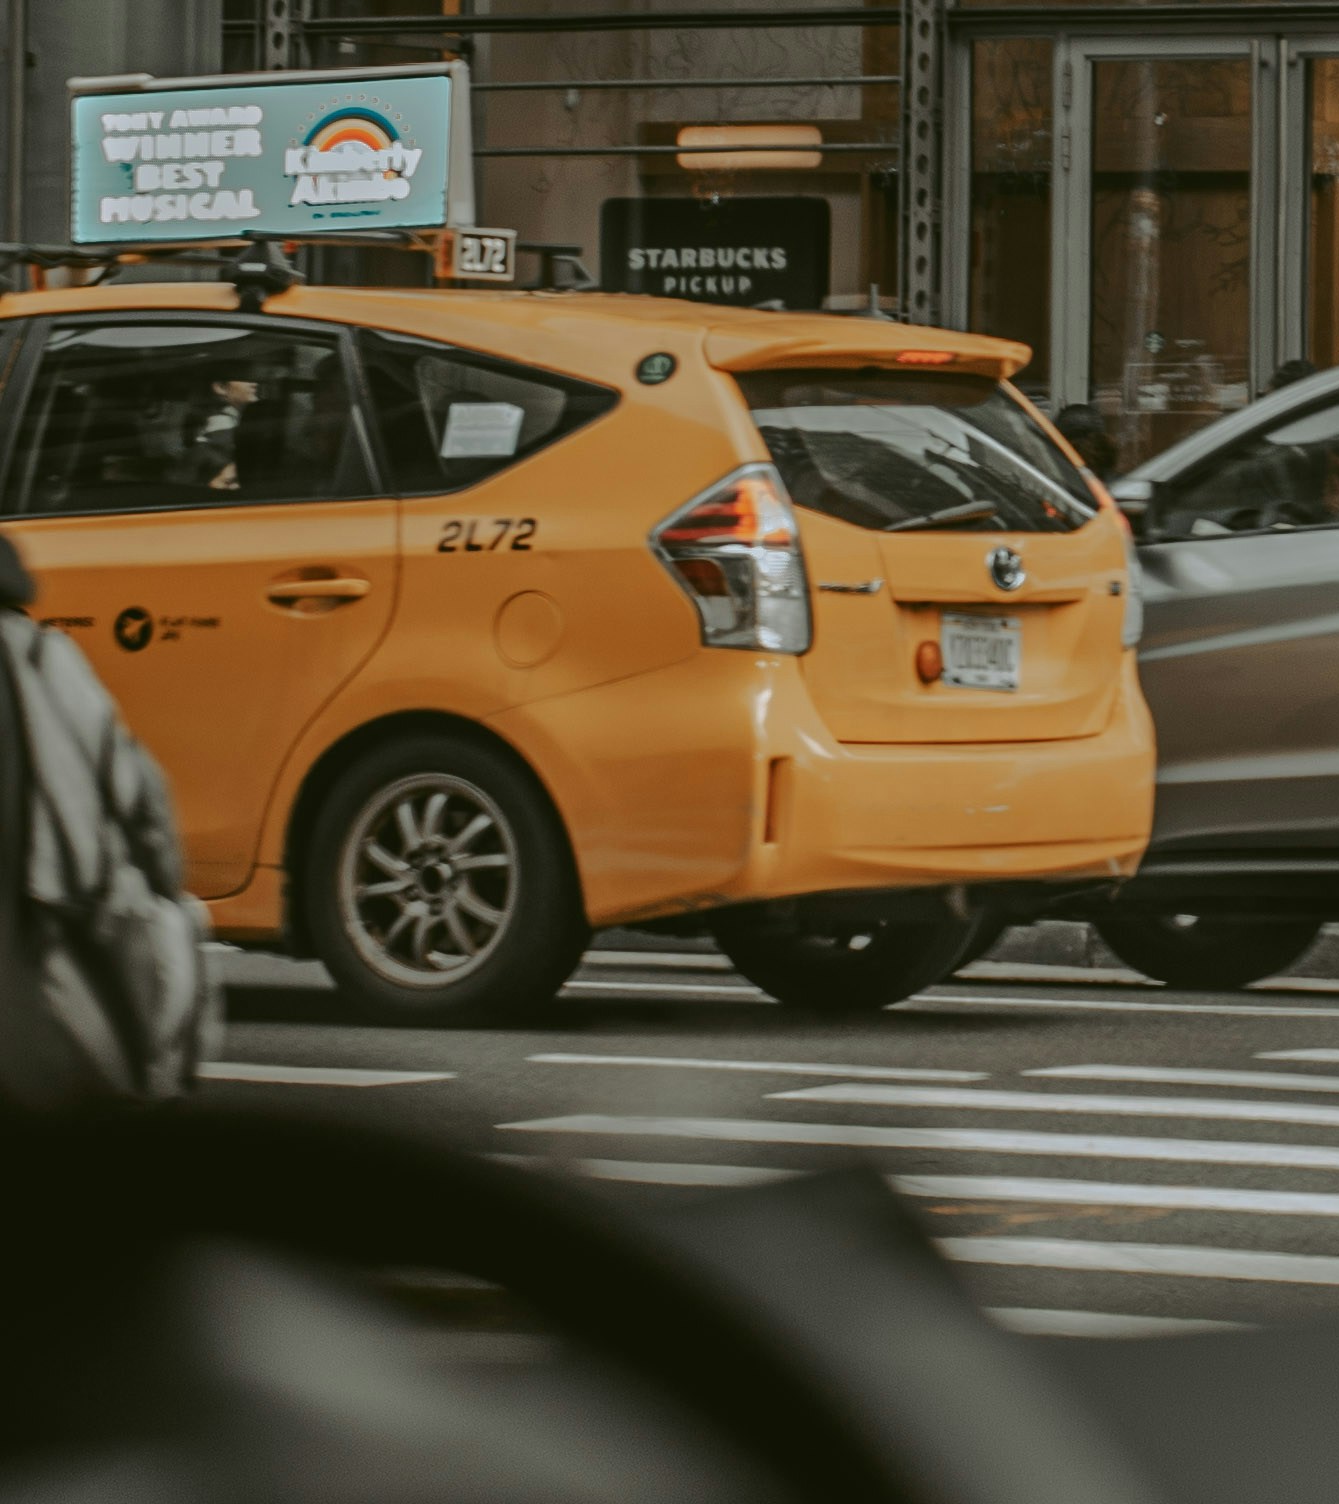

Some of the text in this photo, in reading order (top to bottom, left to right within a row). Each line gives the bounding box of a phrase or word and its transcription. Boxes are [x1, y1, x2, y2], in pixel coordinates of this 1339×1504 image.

[101, 104, 263, 134] TONY AWARD
[101, 128, 263, 163] WINNER
[134, 159, 225, 192] BEST
[100, 188, 262, 224] MUSICAL
[460, 236, 507, 273] 2L72
[627, 246, 788, 271] STARBUCKS
[663, 275, 752, 295] PICKUP
[437, 517, 538, 553] 2L72
